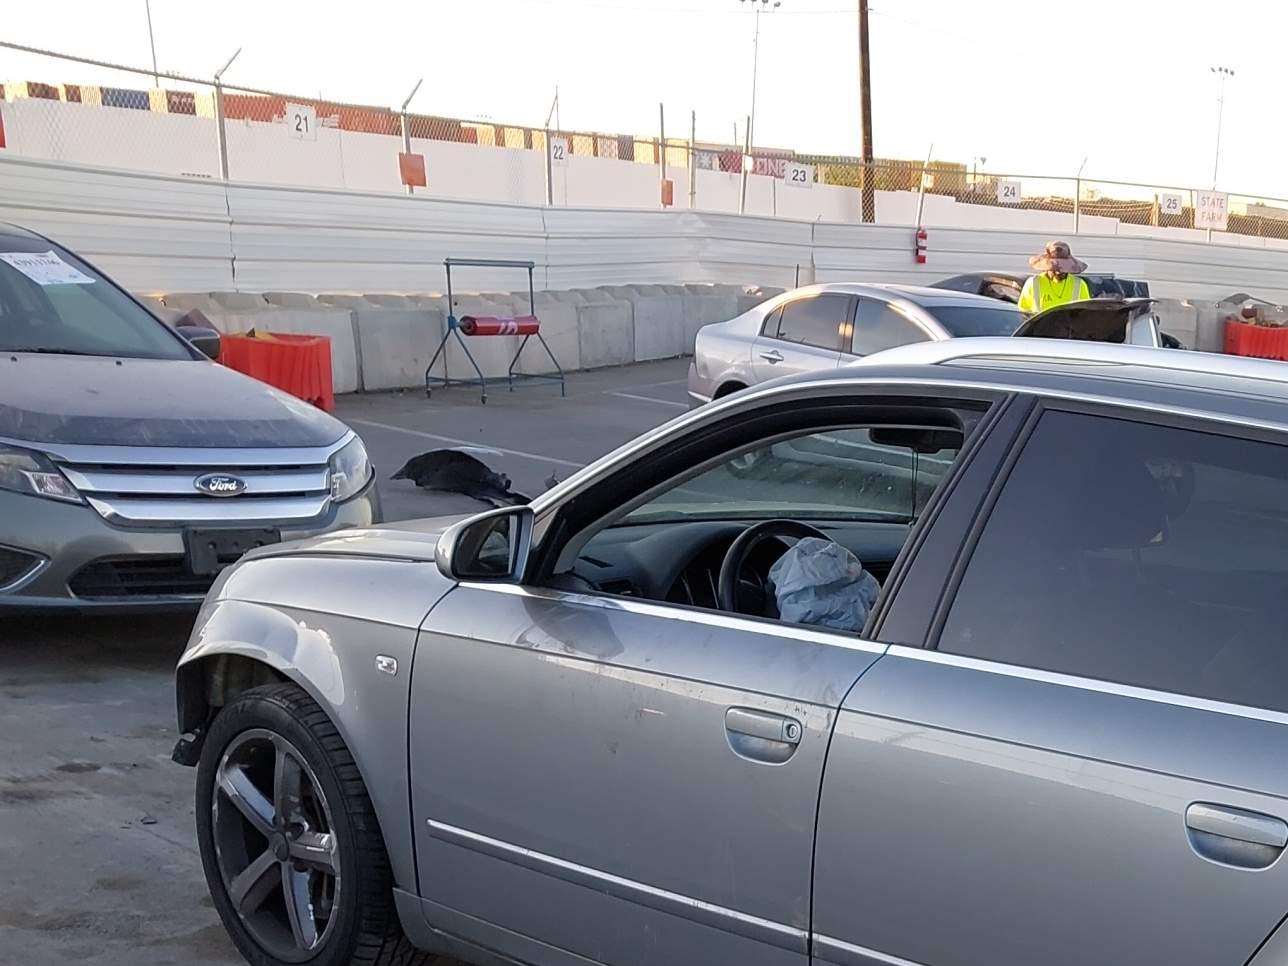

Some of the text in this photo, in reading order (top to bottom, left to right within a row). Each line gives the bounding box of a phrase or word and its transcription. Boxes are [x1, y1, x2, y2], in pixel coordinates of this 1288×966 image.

[294, 113, 309, 133] 21
[553, 145, 564, 160] 22
[791, 168, 807, 182] 23
[1003, 186, 1016, 197] 24
[1166, 198, 1178, 209] 25
[1201, 196, 1224, 208] STATE
[209, 477, 238, 491] Ford
